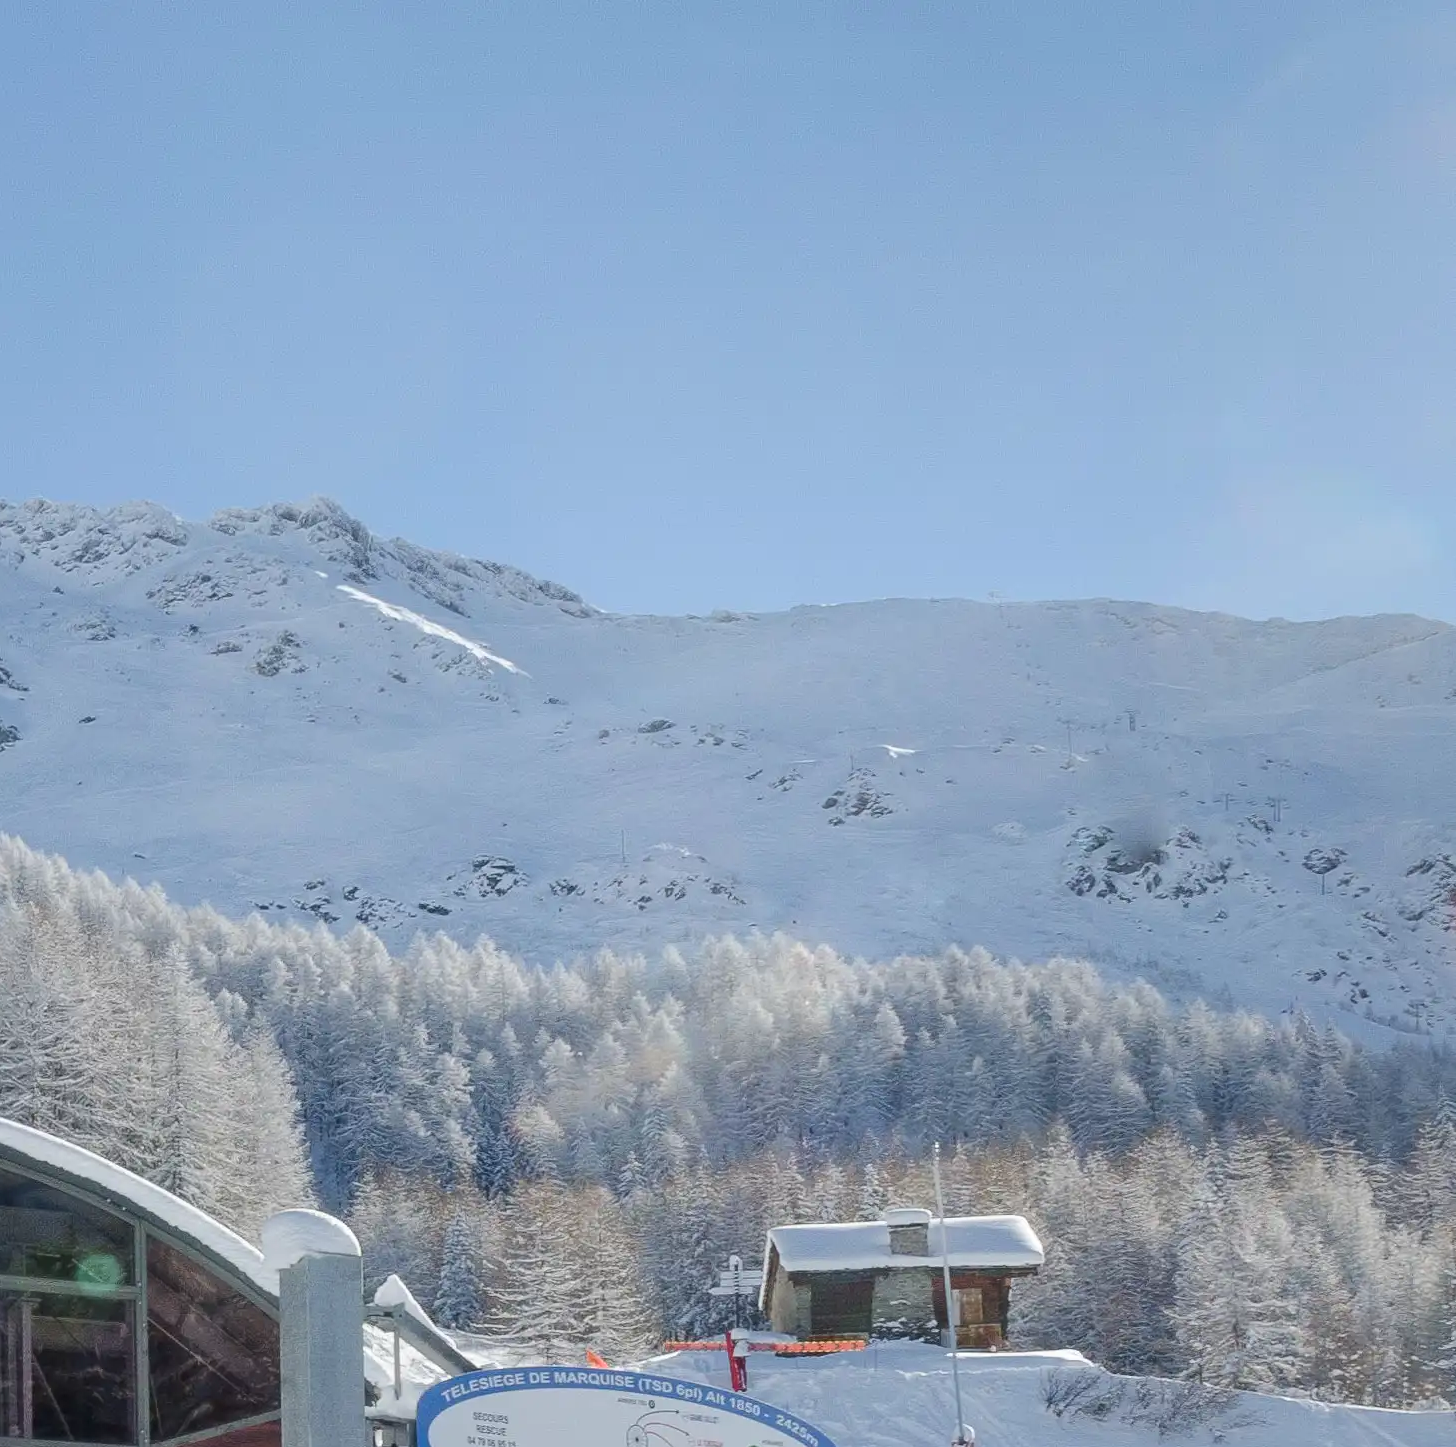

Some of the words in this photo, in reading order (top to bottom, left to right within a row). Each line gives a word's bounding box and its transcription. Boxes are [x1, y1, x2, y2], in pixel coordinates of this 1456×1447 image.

[441, 1373, 526, 1401] TELESIEGE
[529, 1371, 551, 1384] DE
[554, 1372, 635, 1388] MARQUISE
[638, 1378, 673, 1393] (TSD
[676, 1384, 703, 1402] 6pl)
[705, 1391, 726, 1405] Alt
[729, 1398, 761, 1416] 1850
[775, 1415, 819, 1447] 2425m
